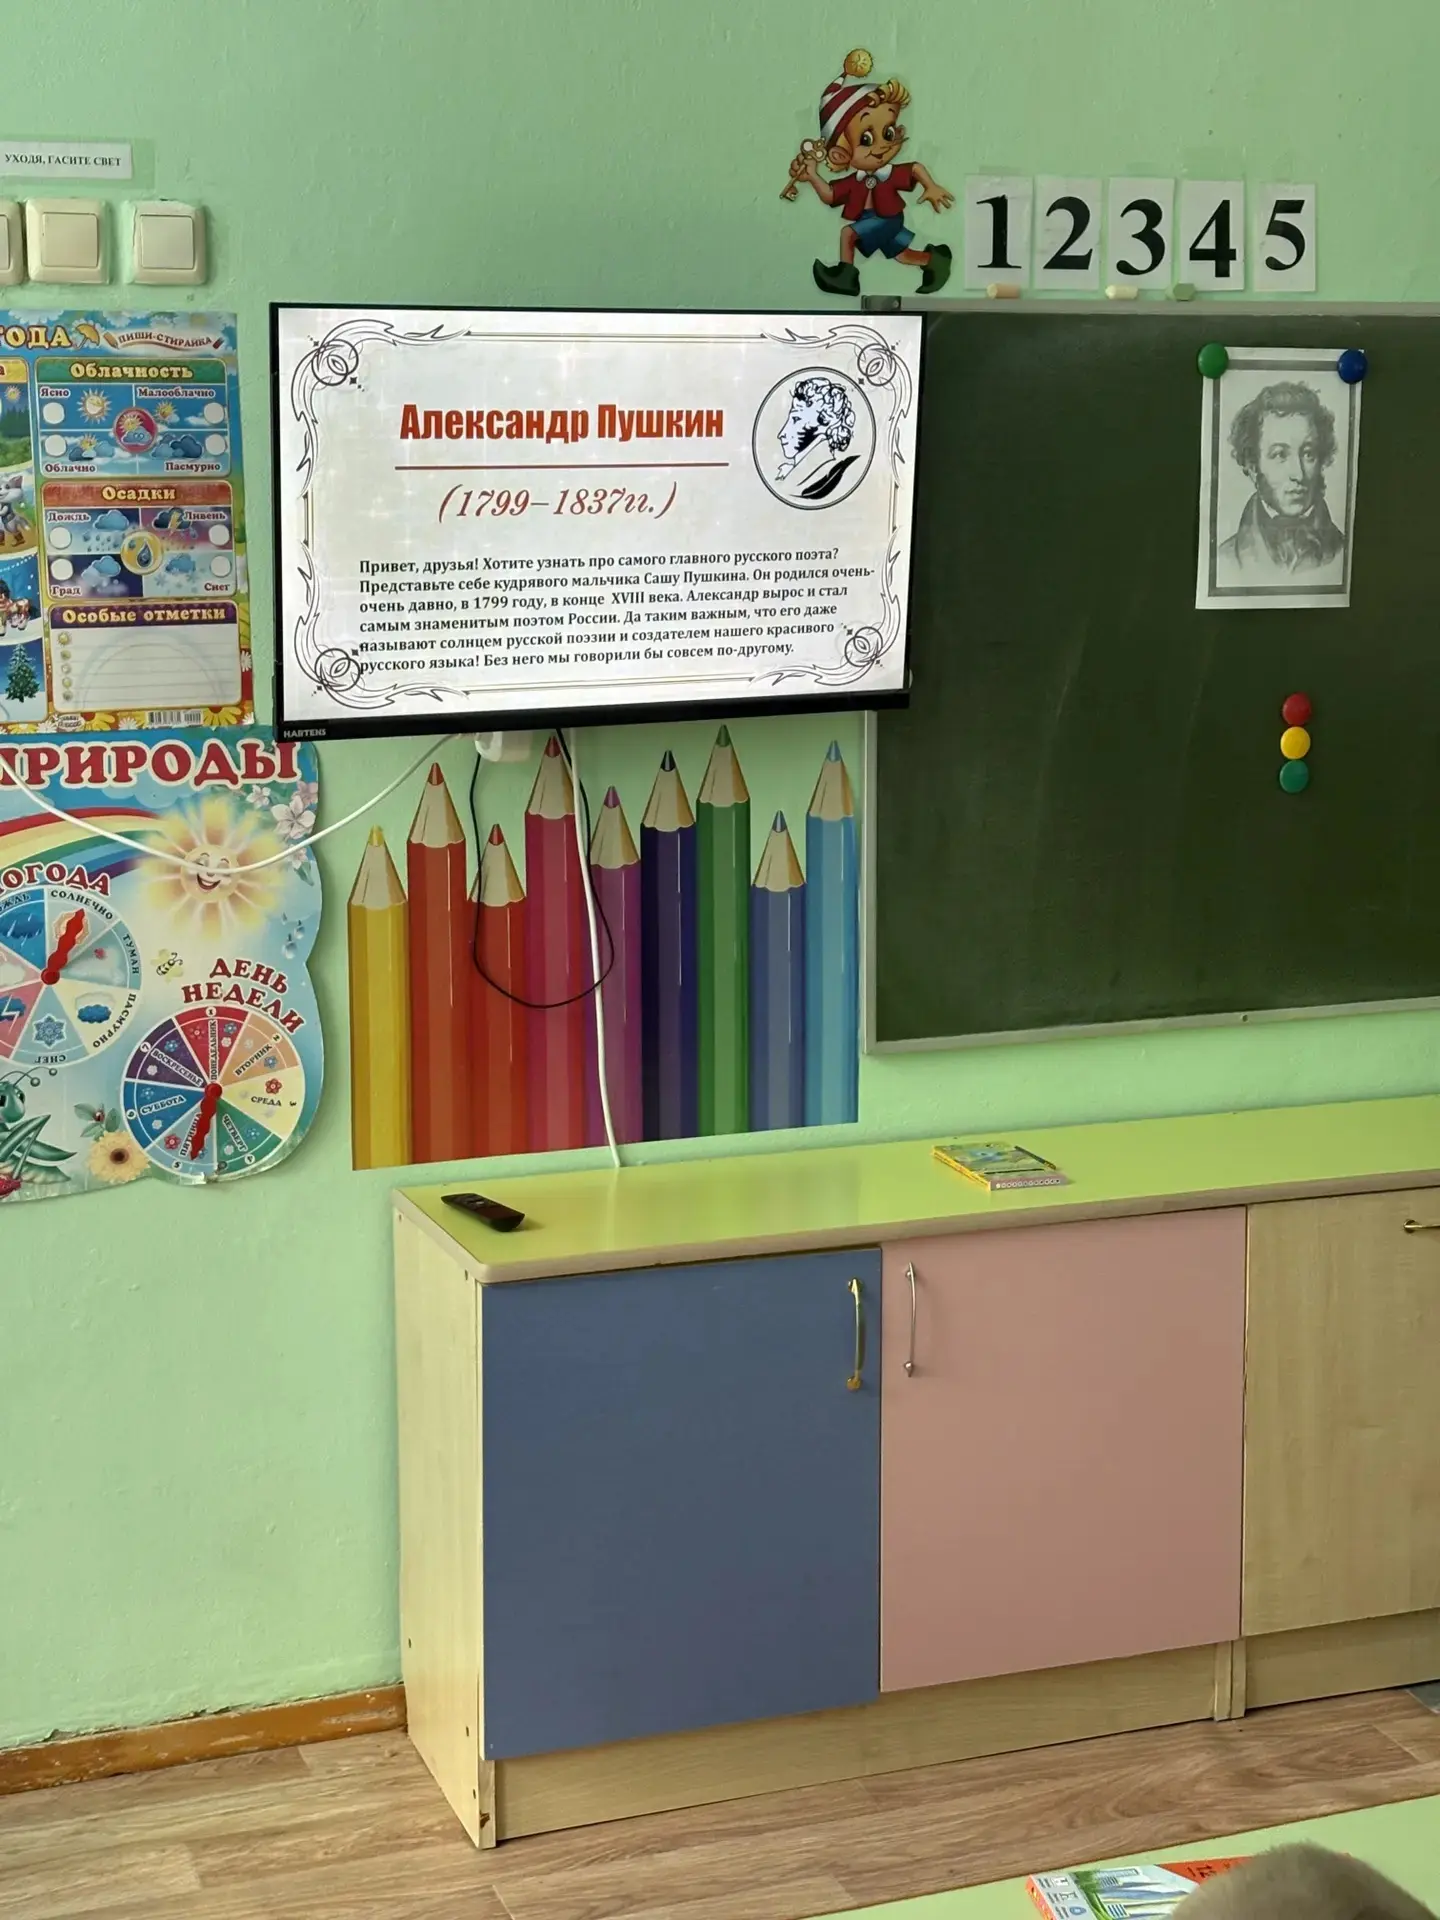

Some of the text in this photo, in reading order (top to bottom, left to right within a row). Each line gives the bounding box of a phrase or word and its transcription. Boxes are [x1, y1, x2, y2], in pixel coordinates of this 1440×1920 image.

[5, 153, 121, 167] УХОДЯ, ГАСИТЕ СВЕТ
[976, 194, 1306, 278] 1 2 3 4 5
[69, 362, 194, 379] Облачность
[41, 387, 216, 398] Ясно Малооблачно
[399, 403, 724, 444] Александр Пушкин
[45, 462, 221, 473] Облачно Пасмурно
[102, 486, 176, 501] Осадки
[48, 511, 226, 522] Дождь Ливень
[359, 547, 839, 577] Привет, друзья! Хотите узнать про самого главного русского поэта?
[52, 582, 230, 596] Град Снег
[359, 567, 875, 597] Представьте себе кудрявого мальчика Сашу Пушкина. Он родился очень-
[359, 586, 848, 614] очень давно, в 1799 году, в конце XVIII века. Александр вырос и стал
[62, 608, 226, 624] Особые отметки
[359, 605, 838, 633] самым знаменитым поэтом России. Да таким важным, что его даже
[358, 623, 835, 653] называют солнцем русской поэзии и создателем нашего красивого
[359, 643, 794, 674] русского языка! Без него мы говорили бы совсем по-другому.
[0, 863, 110, 896] ОГОДА
[51, 889, 114, 920] СОЛНЕЧНО
[122, 933, 140, 975] ТУМАН
[209, 958, 288, 994] ДЕНЬ
[92, 992, 137, 1049] ПАСМУРНО
[181, 982, 305, 1034] НЕДЕЛИ
[35, 1054, 67, 1065] СНЕГ
[209, 1019, 218, 1081] ПОНЕДЕЛЬНИК
[234, 1043, 273, 1076] ВТОРНИК
[151, 1048, 202, 1086] ВОСКРЕСЕНЬЕ
[141, 1095, 184, 1114] СУББОТА
[251, 1096, 282, 1107] СРЕДА
[223, 1115, 247, 1151] ЧЕТВЕРГ
